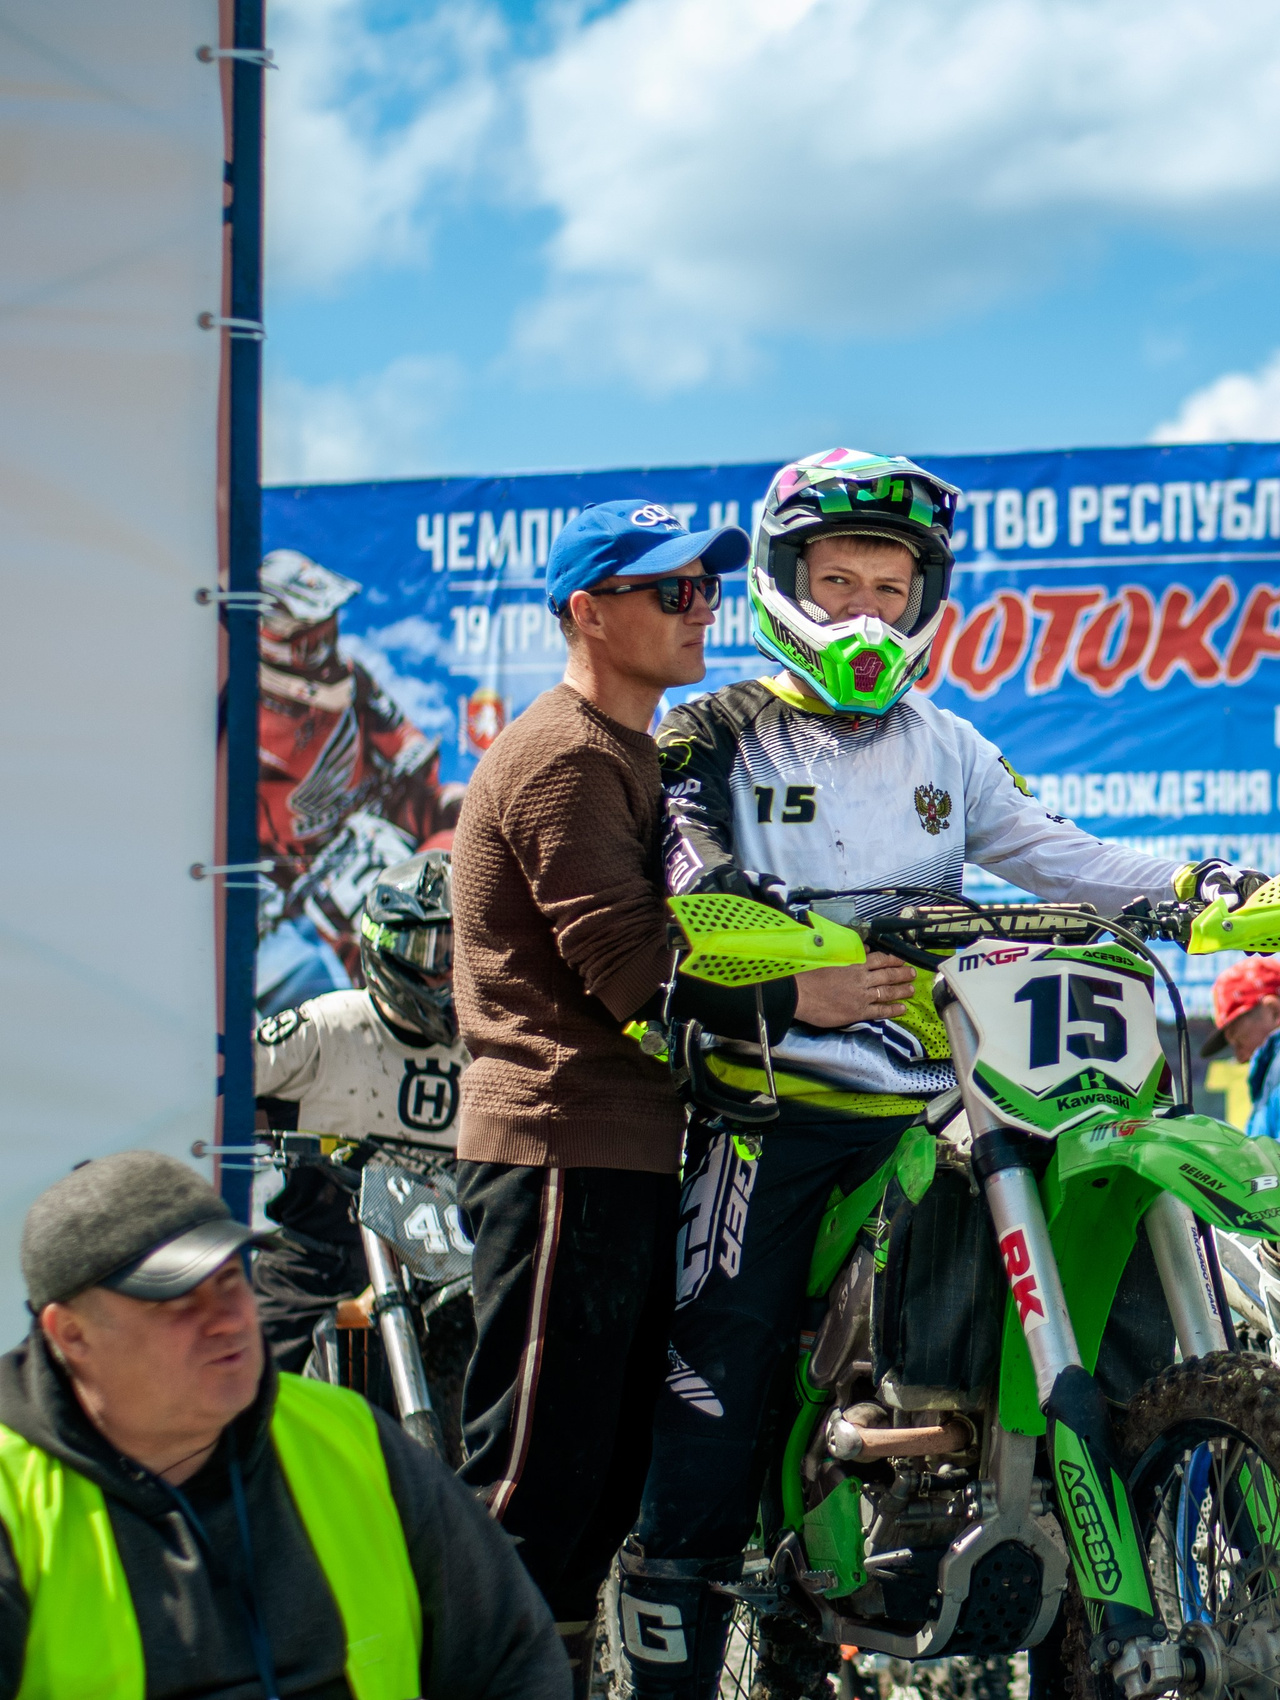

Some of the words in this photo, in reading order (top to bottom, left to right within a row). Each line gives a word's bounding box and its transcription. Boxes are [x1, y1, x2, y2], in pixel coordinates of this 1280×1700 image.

[450, 605, 490, 655] 19
[754, 785, 818, 824] 15
[958, 945, 1030, 972] MXGP
[1013, 972, 1129, 1070] 15
[1056, 1092, 1130, 1112] Kawasaki
[1000, 1228, 1046, 1329] RK
[1205, 1282, 1219, 1315] CHAIN
